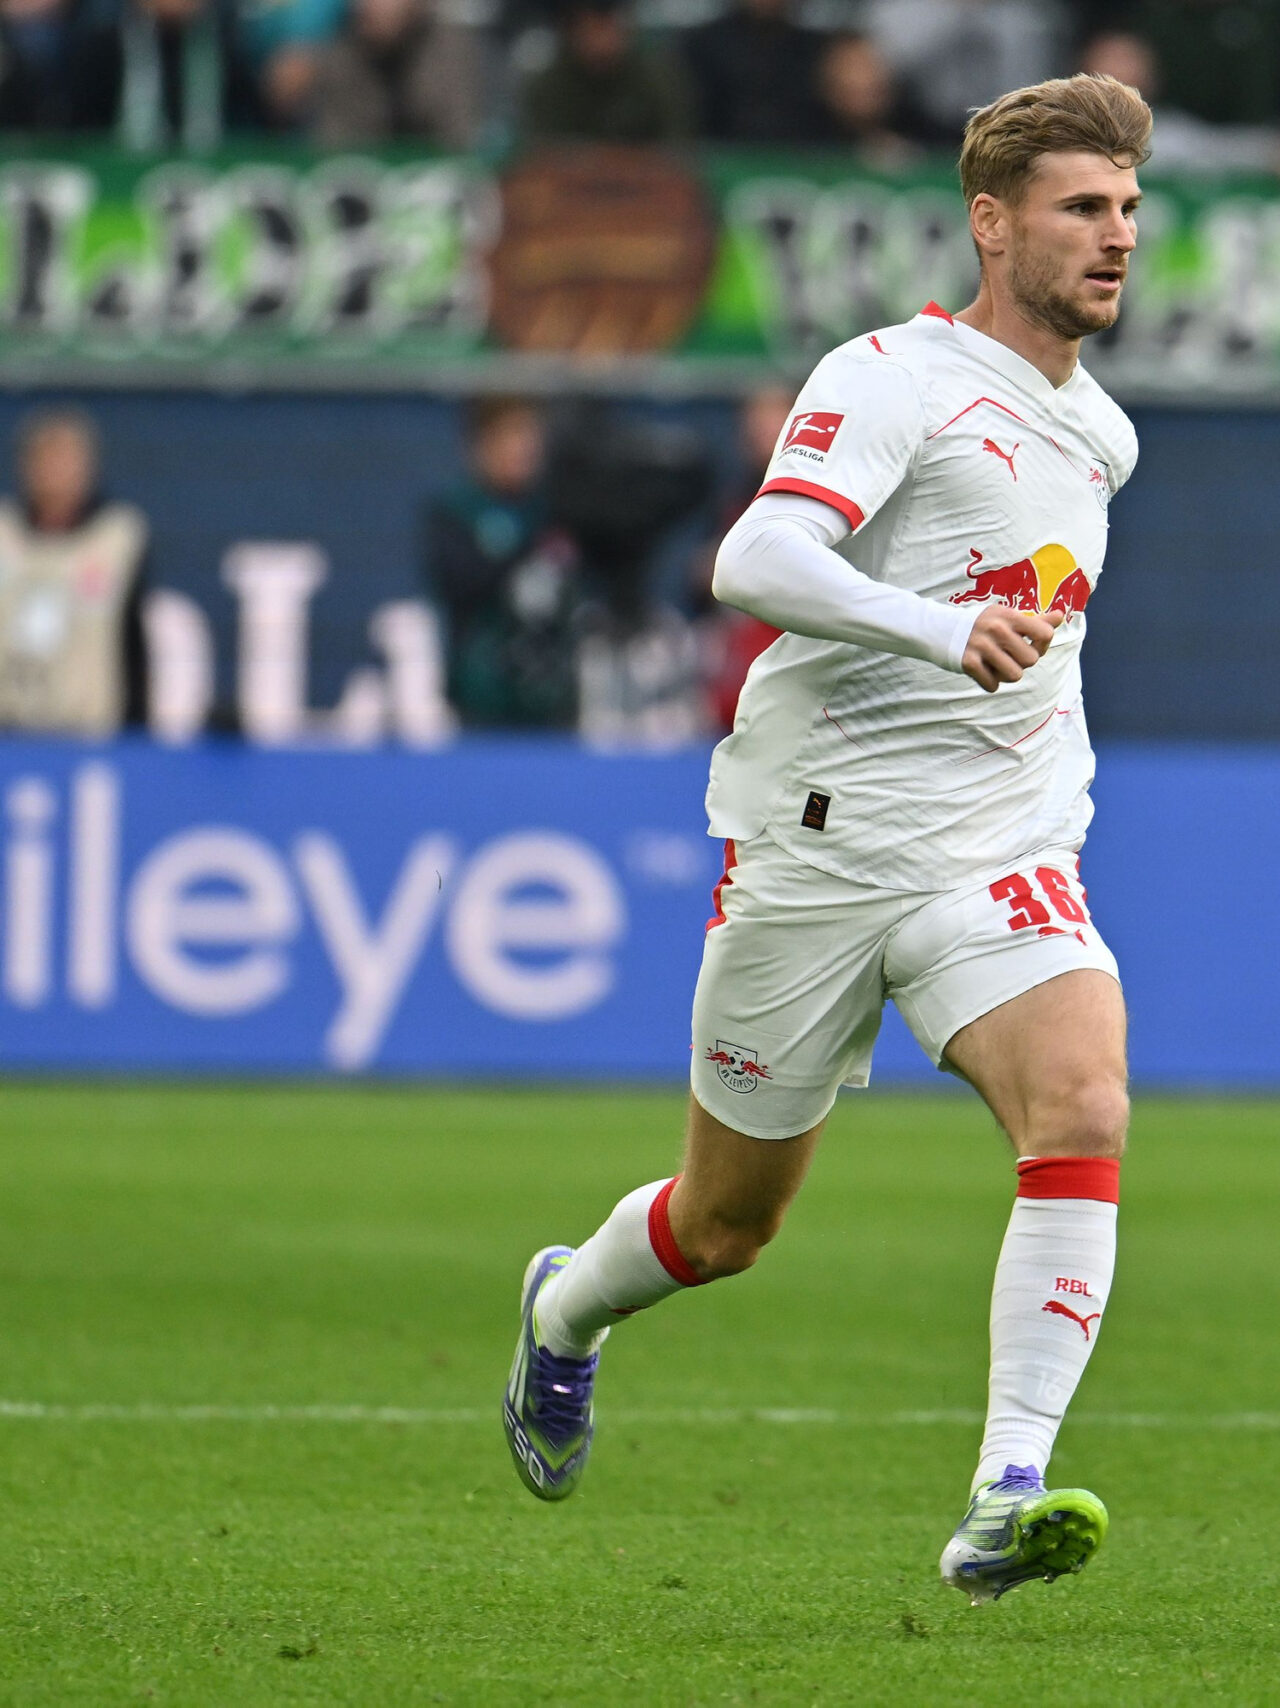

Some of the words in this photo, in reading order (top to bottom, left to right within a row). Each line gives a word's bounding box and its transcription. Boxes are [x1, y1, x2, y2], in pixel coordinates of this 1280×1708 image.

[5, 763, 625, 1070] ileye
[988, 866, 1089, 931] 36
[1054, 1277, 1094, 1298] RBL
